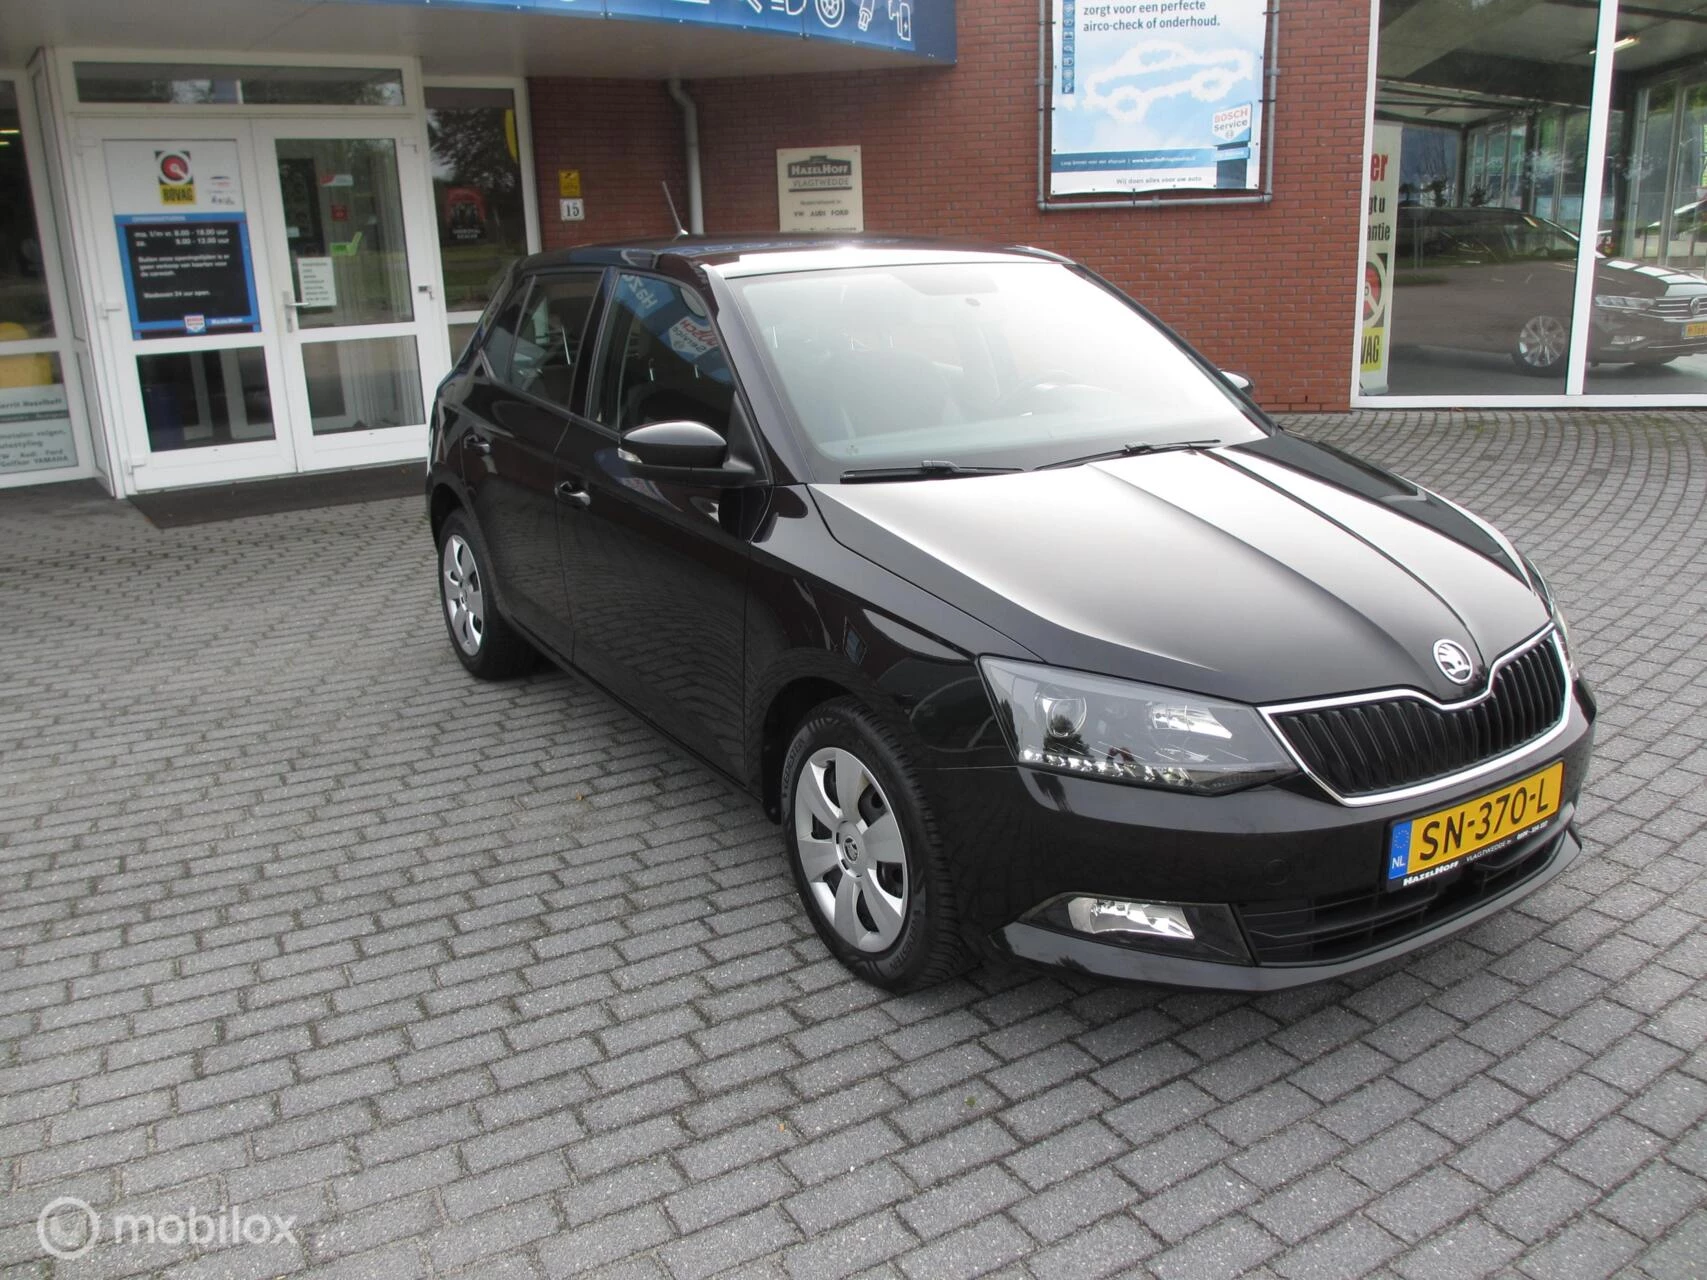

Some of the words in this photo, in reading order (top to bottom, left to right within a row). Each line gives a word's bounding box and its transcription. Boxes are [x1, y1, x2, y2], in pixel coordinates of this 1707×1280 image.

[1083, 5, 1110, 17] zorgt
[1114, 4, 1136, 14] voor
[1139, 3, 1158, 12] een
[1161, 0, 1206, 14] perfecte
[1083, 18, 1144, 32] airco-check
[1146, 17, 1158, 29] of
[1159, 15, 1220, 28] onderhoud.
[1214, 107, 1248, 123] BOSCH
[1214, 119, 1248, 132] Service
[566, 202, 580, 217] 15
[1379, 197, 1385, 213] u
[1420, 778, 1549, 860] SN-370-L
[1391, 856, 1406, 869] NL
